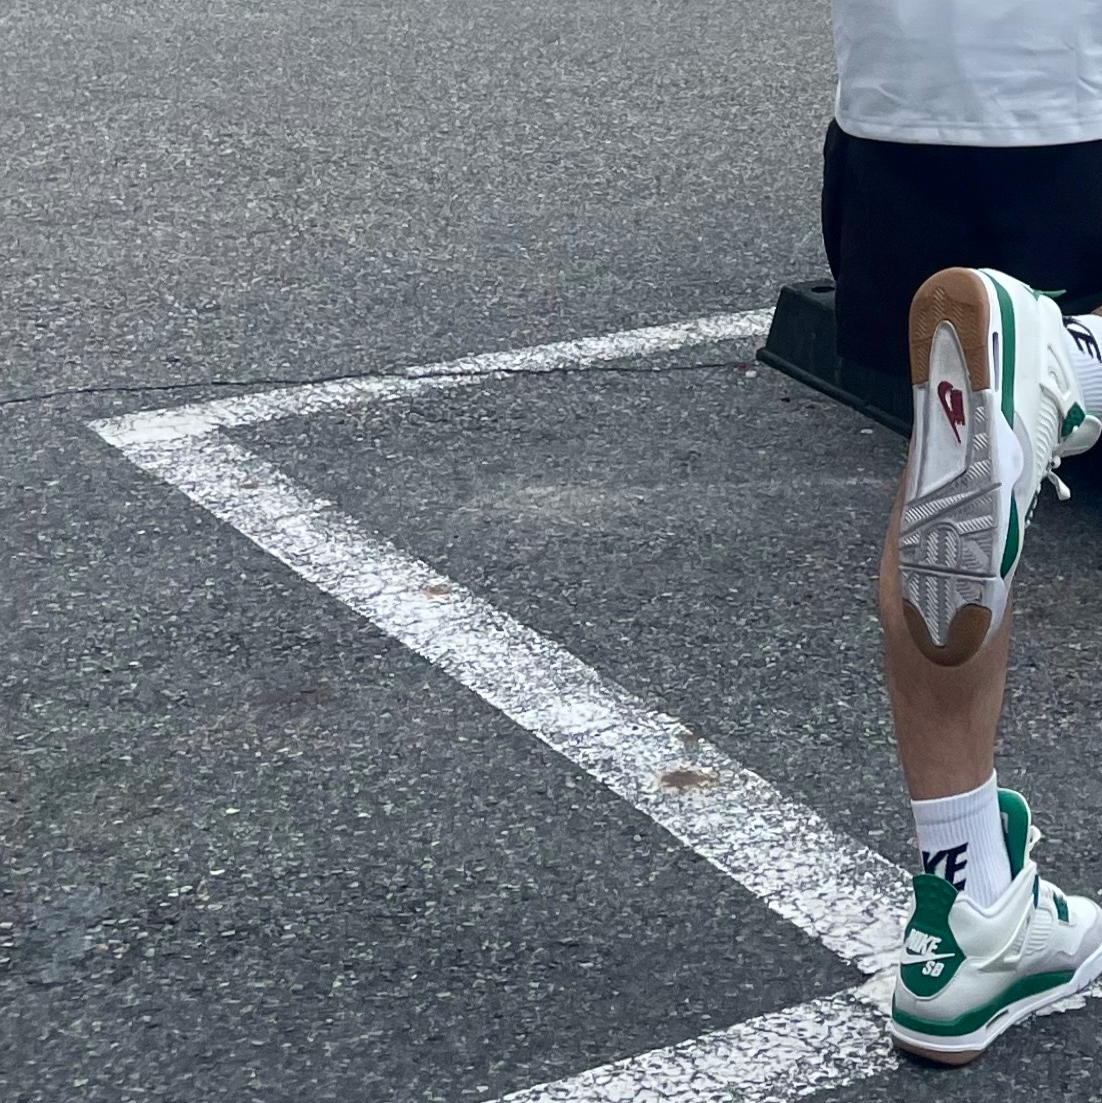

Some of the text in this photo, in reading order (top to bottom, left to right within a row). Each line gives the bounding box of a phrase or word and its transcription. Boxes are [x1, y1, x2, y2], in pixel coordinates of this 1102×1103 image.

[922, 842, 969, 891] KE
[904, 928, 942, 955] NIKE
[922, 960, 945, 977] SB
